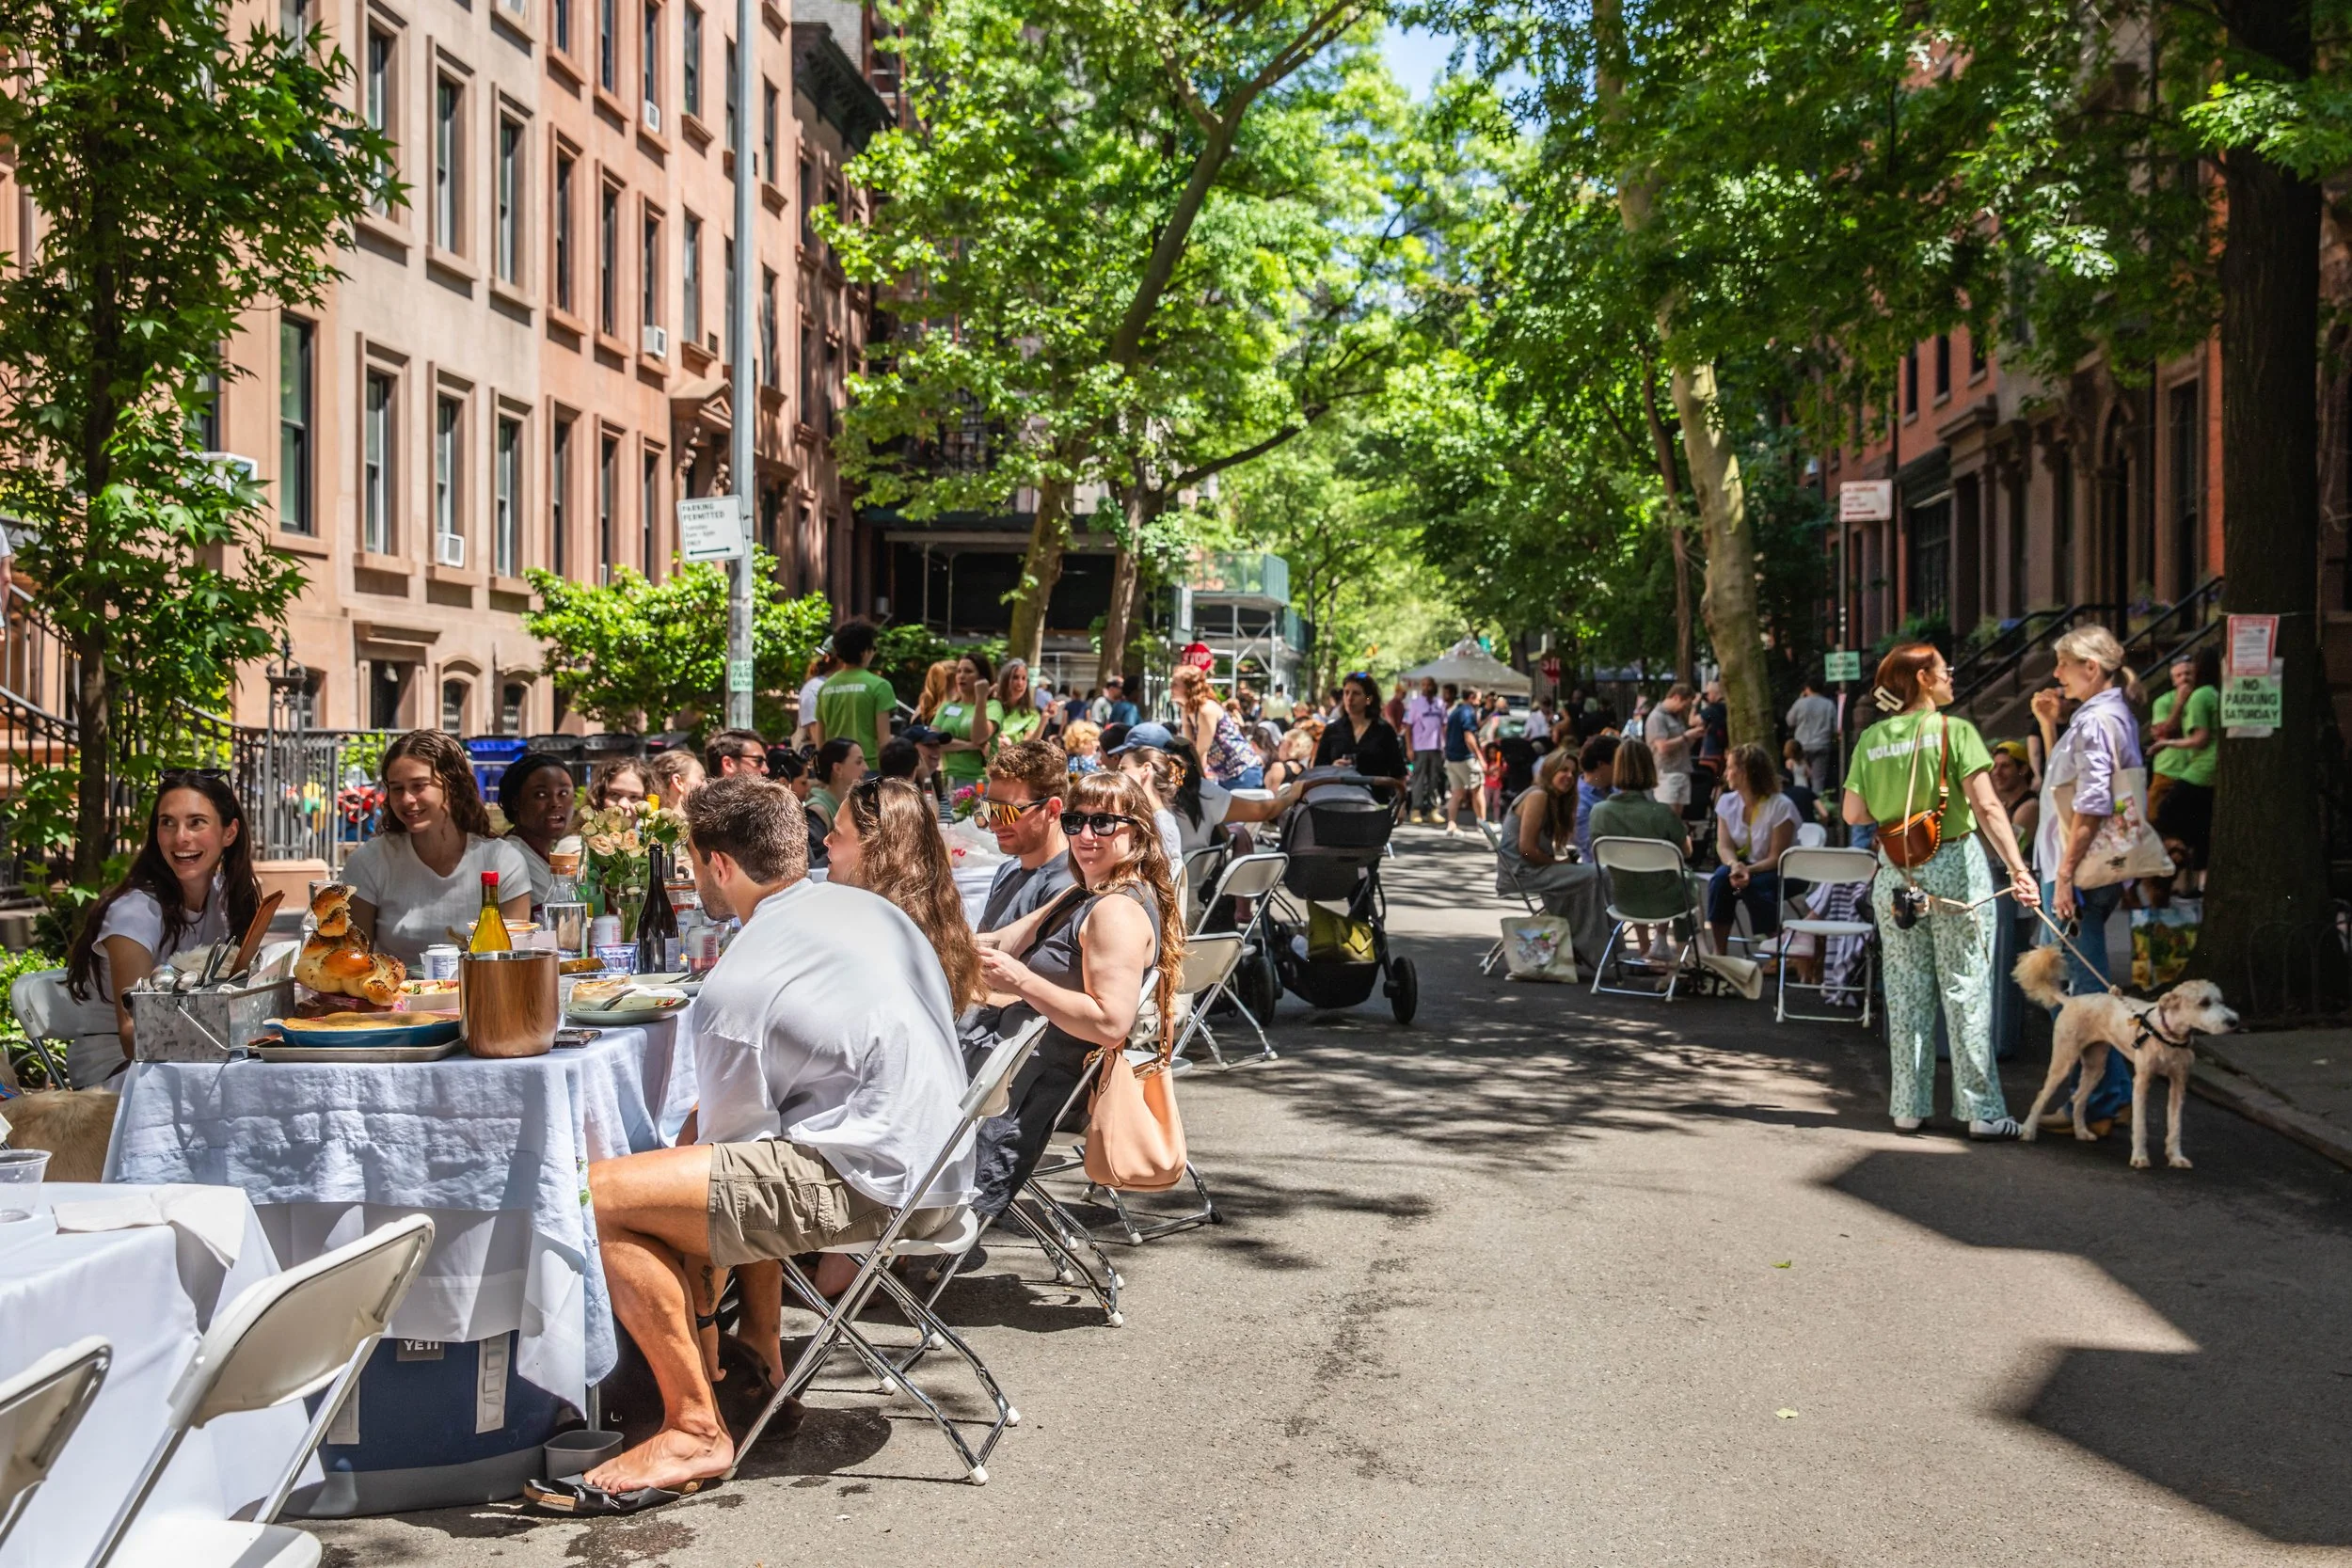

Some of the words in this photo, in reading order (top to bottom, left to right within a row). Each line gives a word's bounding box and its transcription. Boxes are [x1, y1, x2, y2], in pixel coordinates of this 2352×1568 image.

[682, 503, 714, 512] PARKING
[683, 511, 725, 521] PERMITTED
[1183, 652, 1212, 666] STOP
[2242, 679, 2259, 690] NO
[2225, 692, 2278, 705] PARKING
[2224, 708, 2278, 720] SATURDAY
[405, 1340, 438, 1351] YETI
